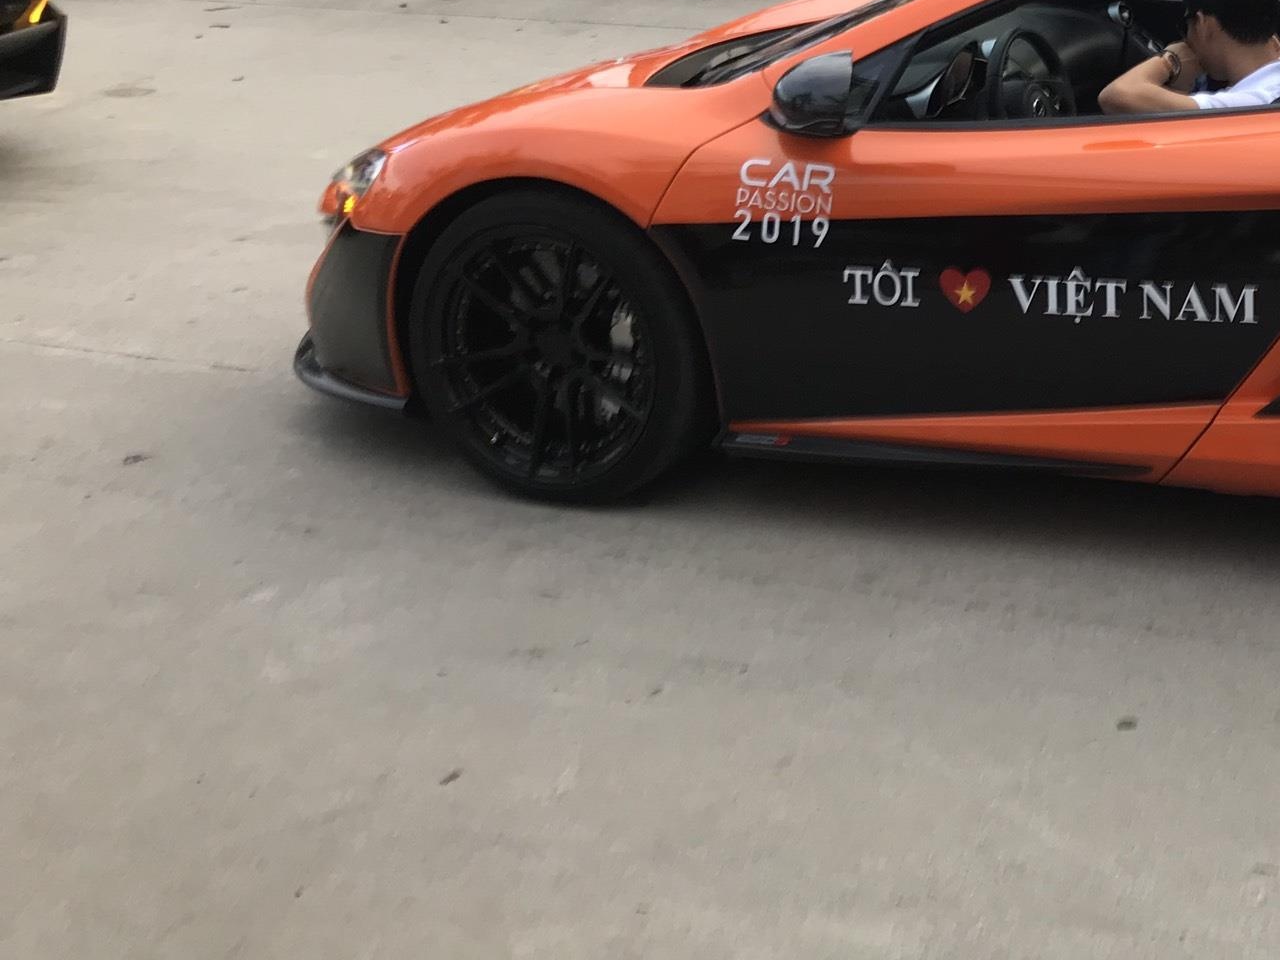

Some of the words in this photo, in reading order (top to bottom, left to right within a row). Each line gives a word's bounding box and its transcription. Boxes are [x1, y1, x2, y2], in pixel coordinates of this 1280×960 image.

[740, 158, 836, 193] CAR
[735, 187, 833, 215] PASSION
[731, 208, 830, 248] 2019
[842, 259, 921, 307] TÔI
[1008, 265, 1128, 324] VIỆT
[1138, 280, 1259, 324] NAM
